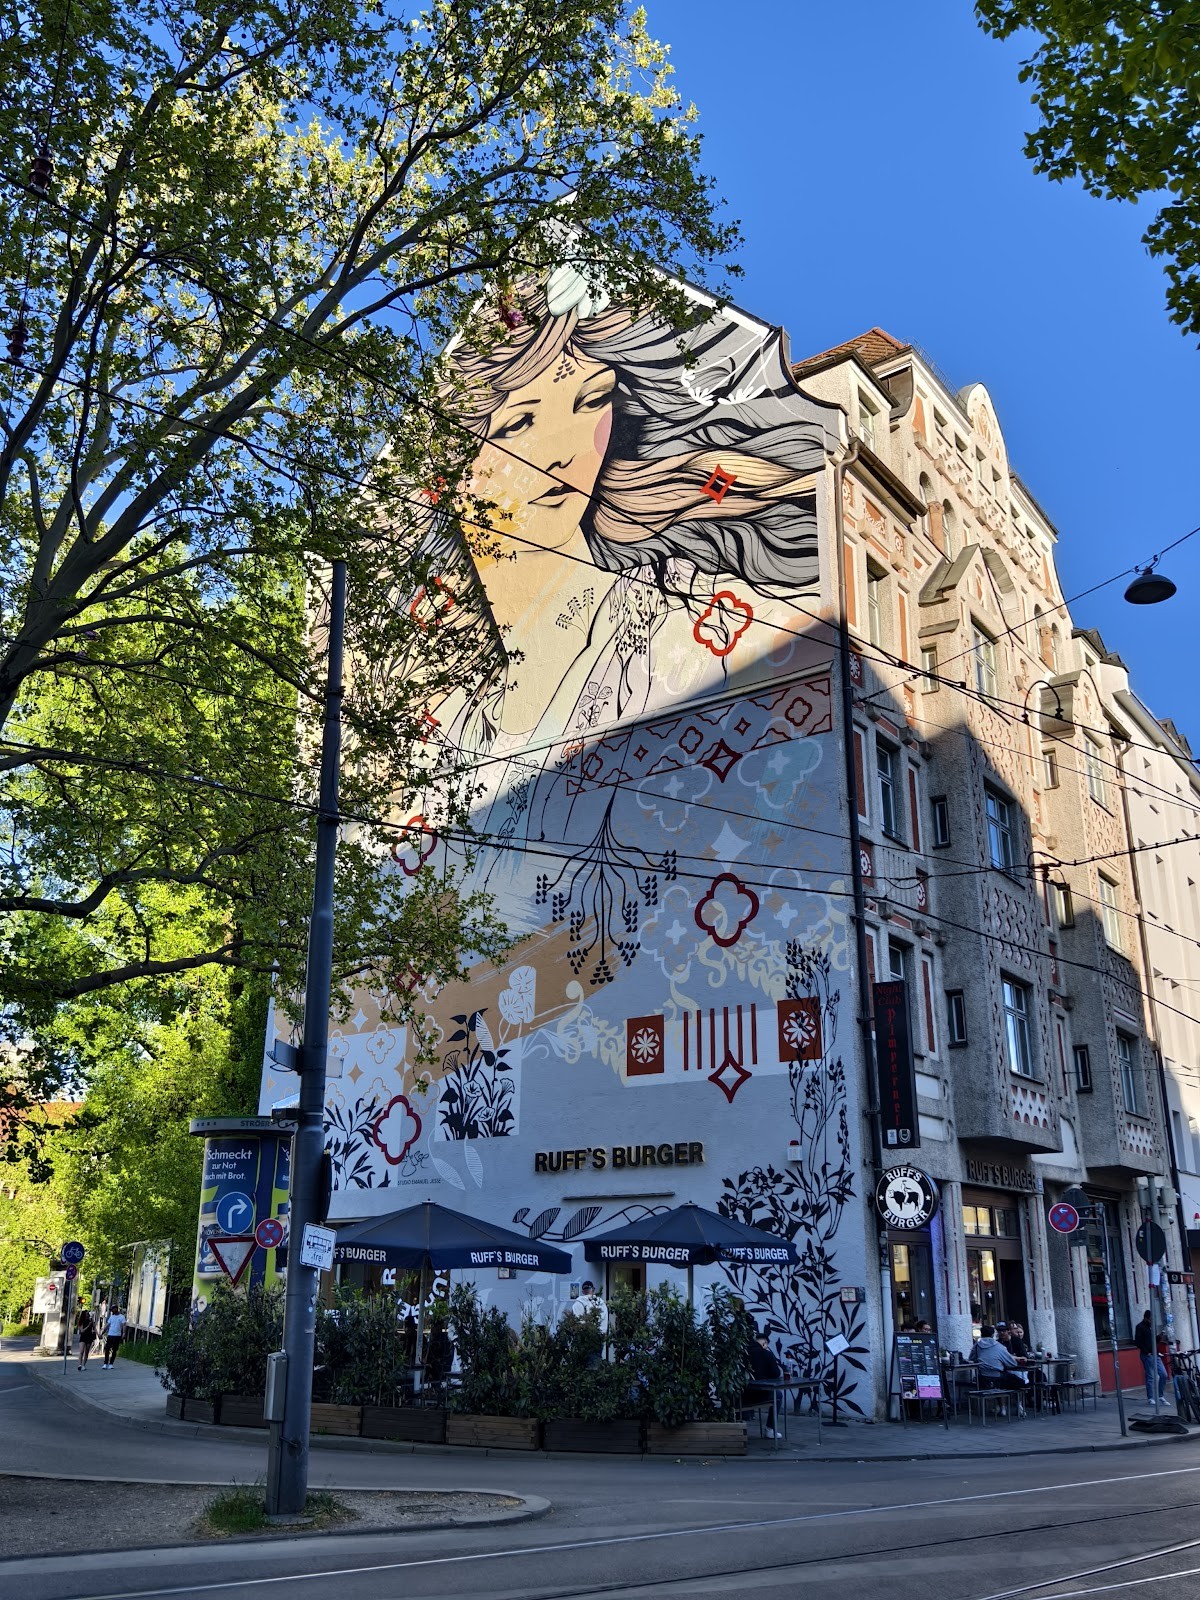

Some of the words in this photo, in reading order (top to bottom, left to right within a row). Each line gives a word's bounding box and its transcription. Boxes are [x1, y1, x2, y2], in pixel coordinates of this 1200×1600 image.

[886, 1007, 901, 1126] Pimpernel
[612, 1142, 704, 1168] BURGER
[216, 1172, 227, 1180] mit
[1002, 1166, 1037, 1192] BURGER
[883, 1209, 929, 1228] BURGER
[313, 1252, 323, 1262] frei
[334, 1247, 345, 1259] F'S
[346, 1247, 387, 1262] BURGER
[505, 1251, 539, 1266] BURGER
[641, 1246, 690, 1261] BURGER
[754, 1247, 790, 1261] BURGER
